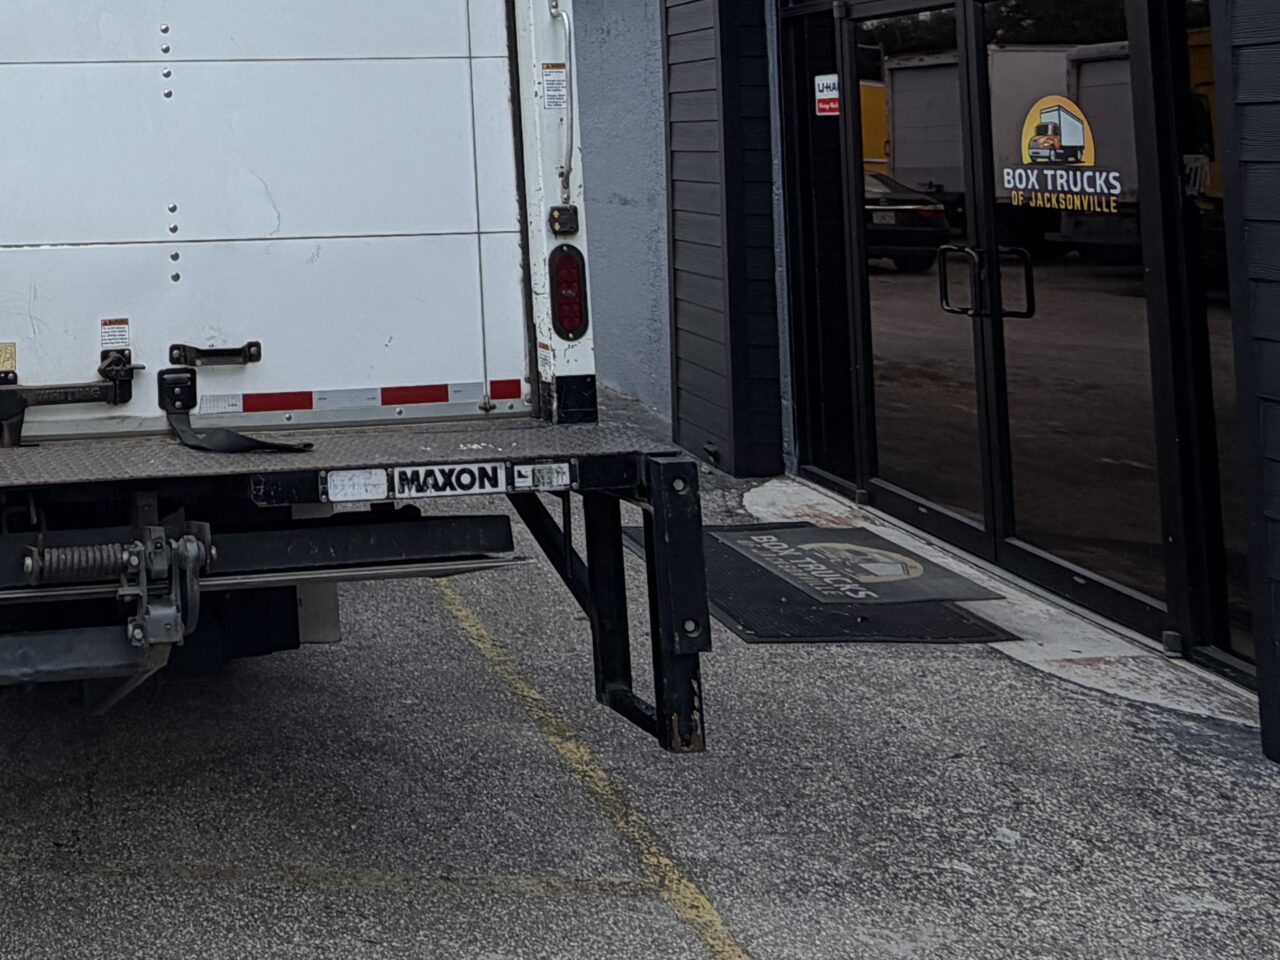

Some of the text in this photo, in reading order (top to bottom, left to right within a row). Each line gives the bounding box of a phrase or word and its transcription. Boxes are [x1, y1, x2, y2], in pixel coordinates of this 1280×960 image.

[1003, 168, 1121, 195] BOX TRUCKS
[1012, 191, 1118, 213] OF JACKSONVILLE
[398, 466, 499, 494] MAXON
[750, 535, 879, 598] BOX TRUCKS
